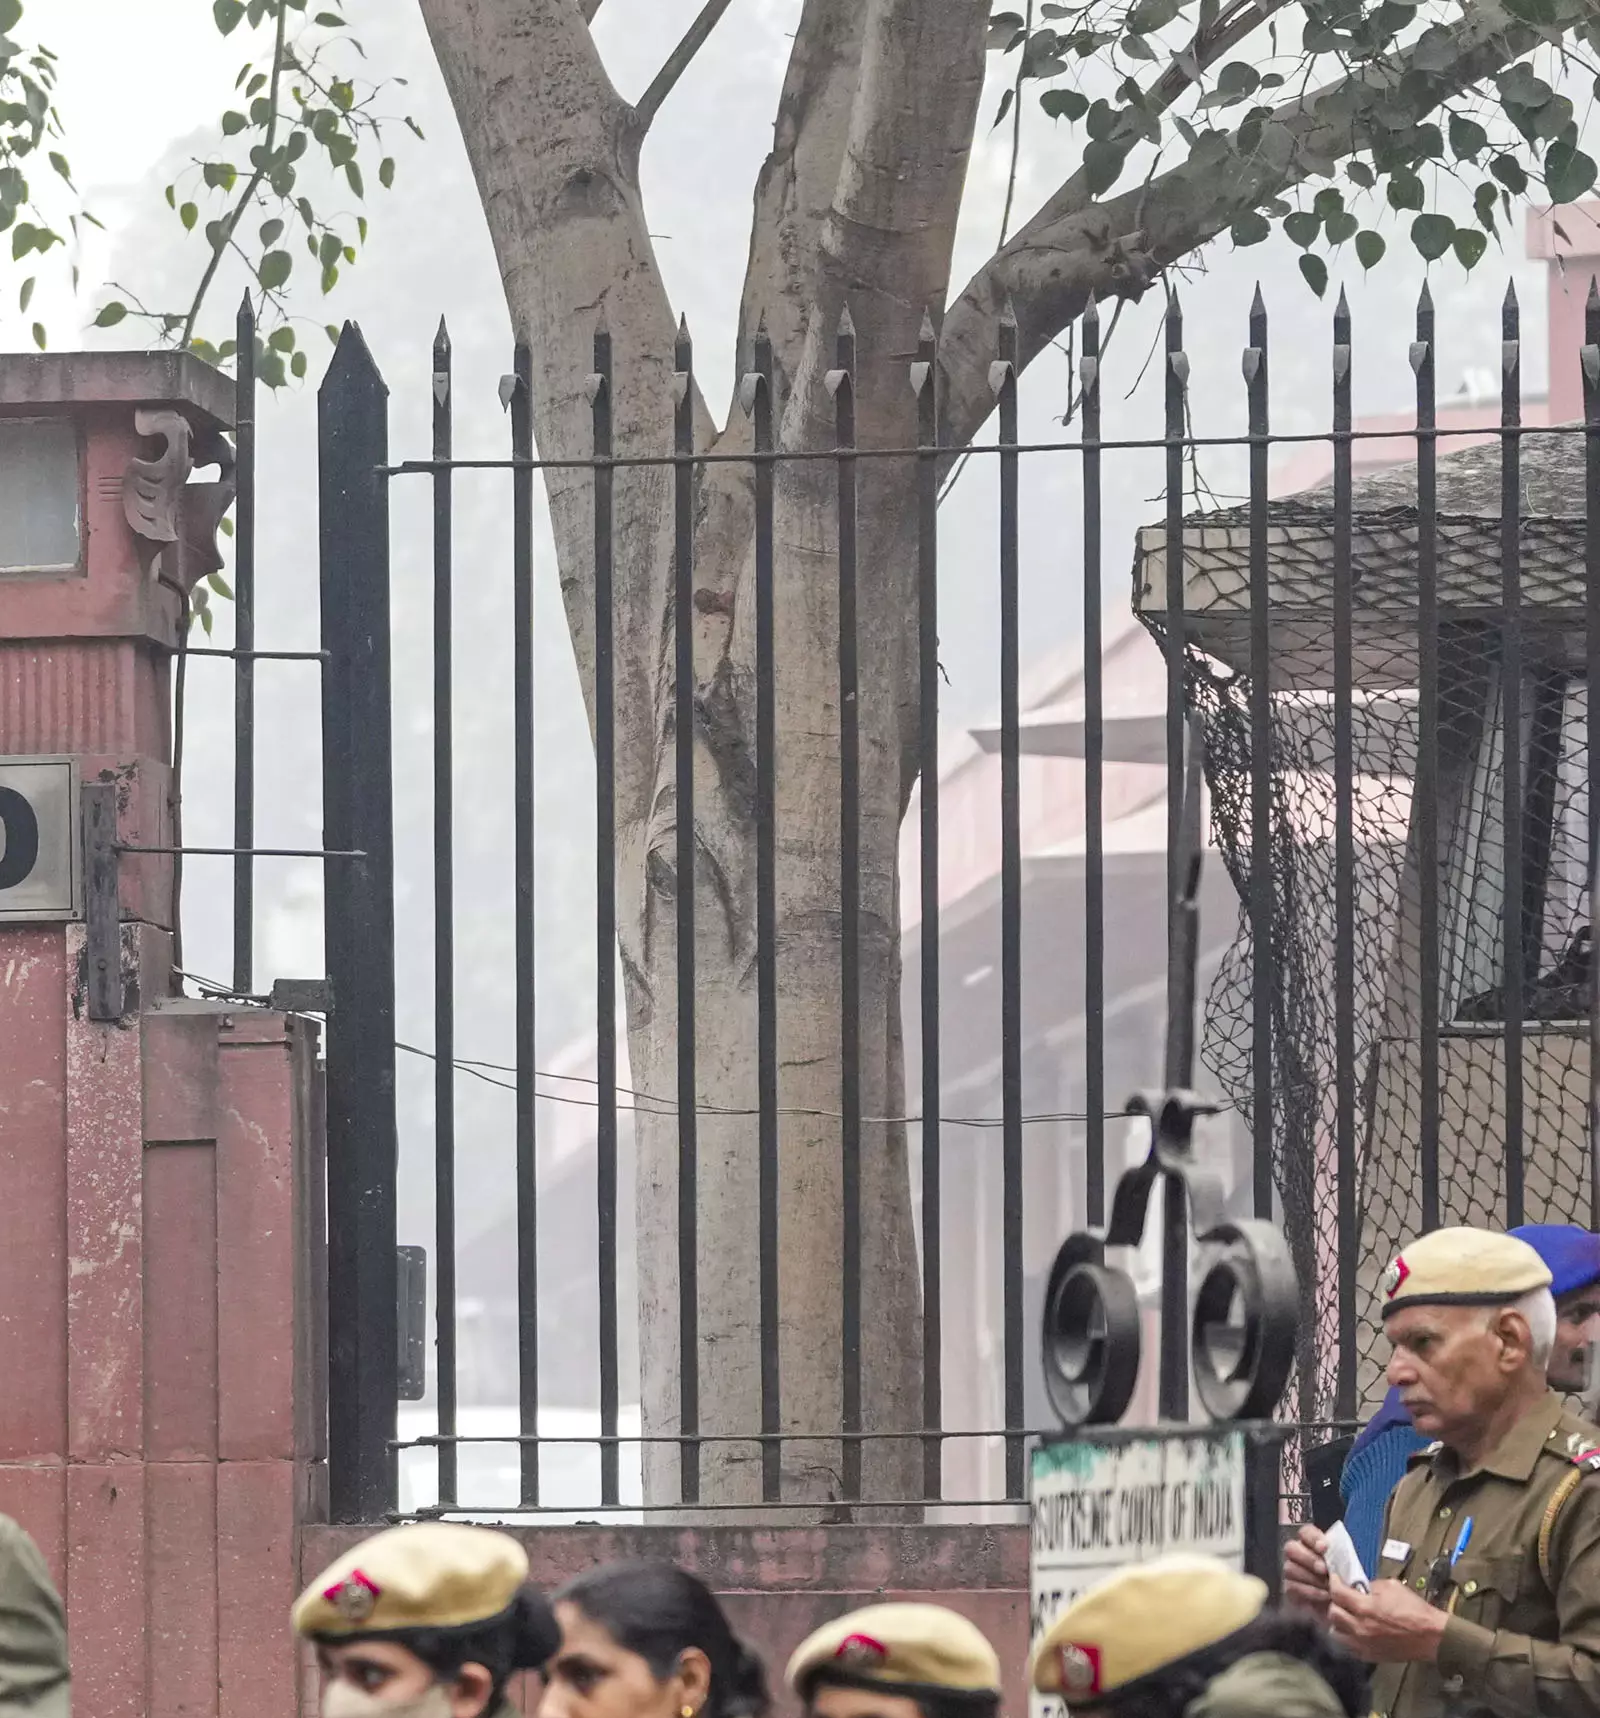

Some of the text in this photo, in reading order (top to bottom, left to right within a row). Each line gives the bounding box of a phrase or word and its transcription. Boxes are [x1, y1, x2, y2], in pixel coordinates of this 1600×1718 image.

[1033, 1489, 1113, 1550] SUPREME
[1120, 1482, 1166, 1545] COURT
[1171, 1480, 1189, 1541] OF
